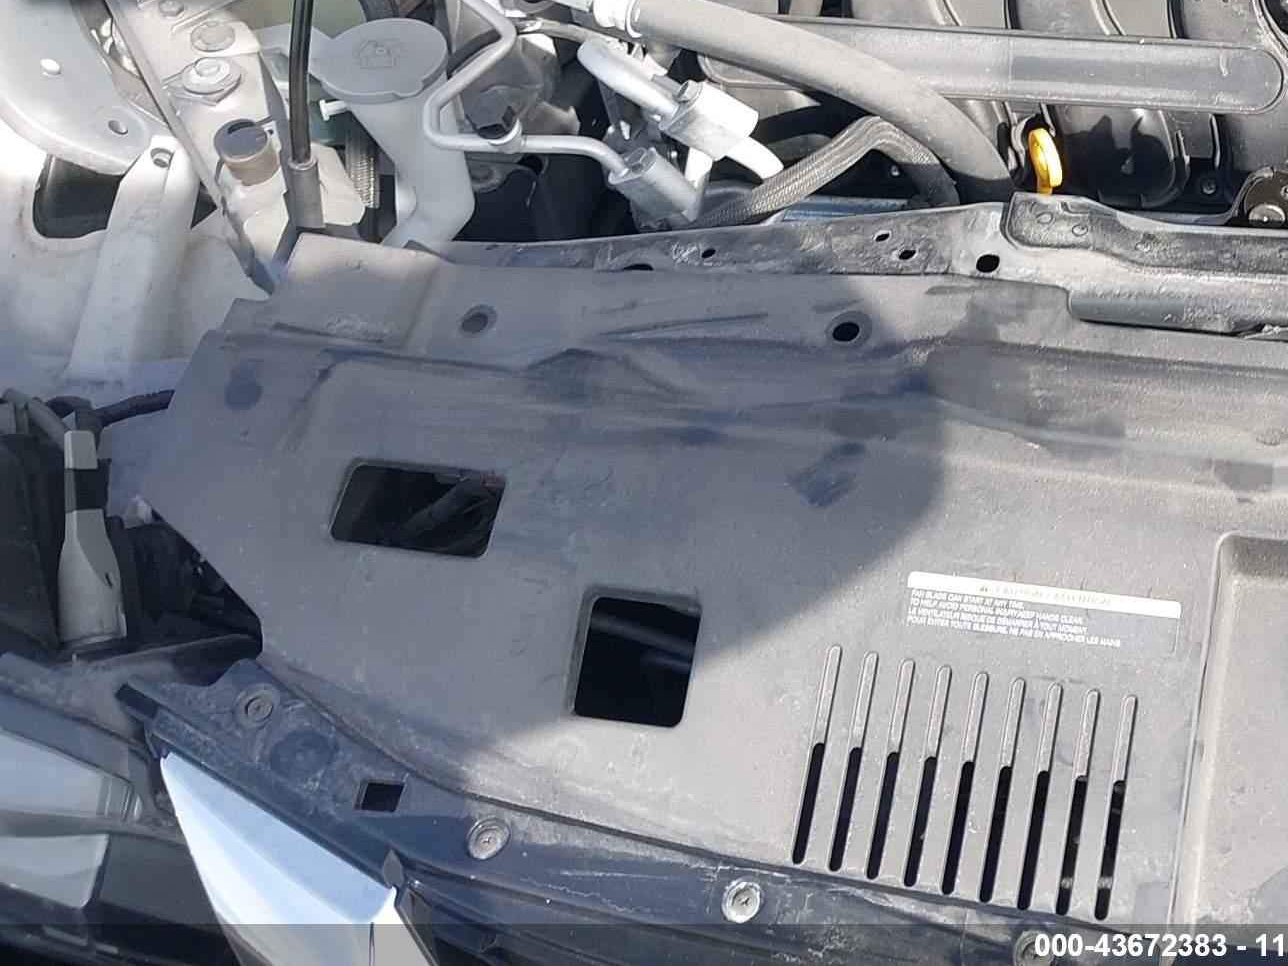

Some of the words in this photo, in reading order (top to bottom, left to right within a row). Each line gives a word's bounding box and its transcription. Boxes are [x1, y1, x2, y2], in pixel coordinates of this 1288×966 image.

[911, 589, 924, 598] FAN
[948, 593, 963, 602] CAN
[963, 594, 984, 605] START
[984, 597, 993, 605] AT
[994, 598, 1008, 607] ANY
[908, 607, 917, 615] LE
[917, 608, 960, 620] VENTILATEUR
[1040, 621, 1058, 631] TOUT
[910, 597, 920, 606] TO
[920, 599, 938, 608] HELP
[938, 601, 959, 611] AVOID
[959, 603, 994, 615] PERSONAL
[1036, 611, 1060, 622] HANDS
[907, 615, 927, 626] POUR
[950, 619, 972, 630] TOUTE
